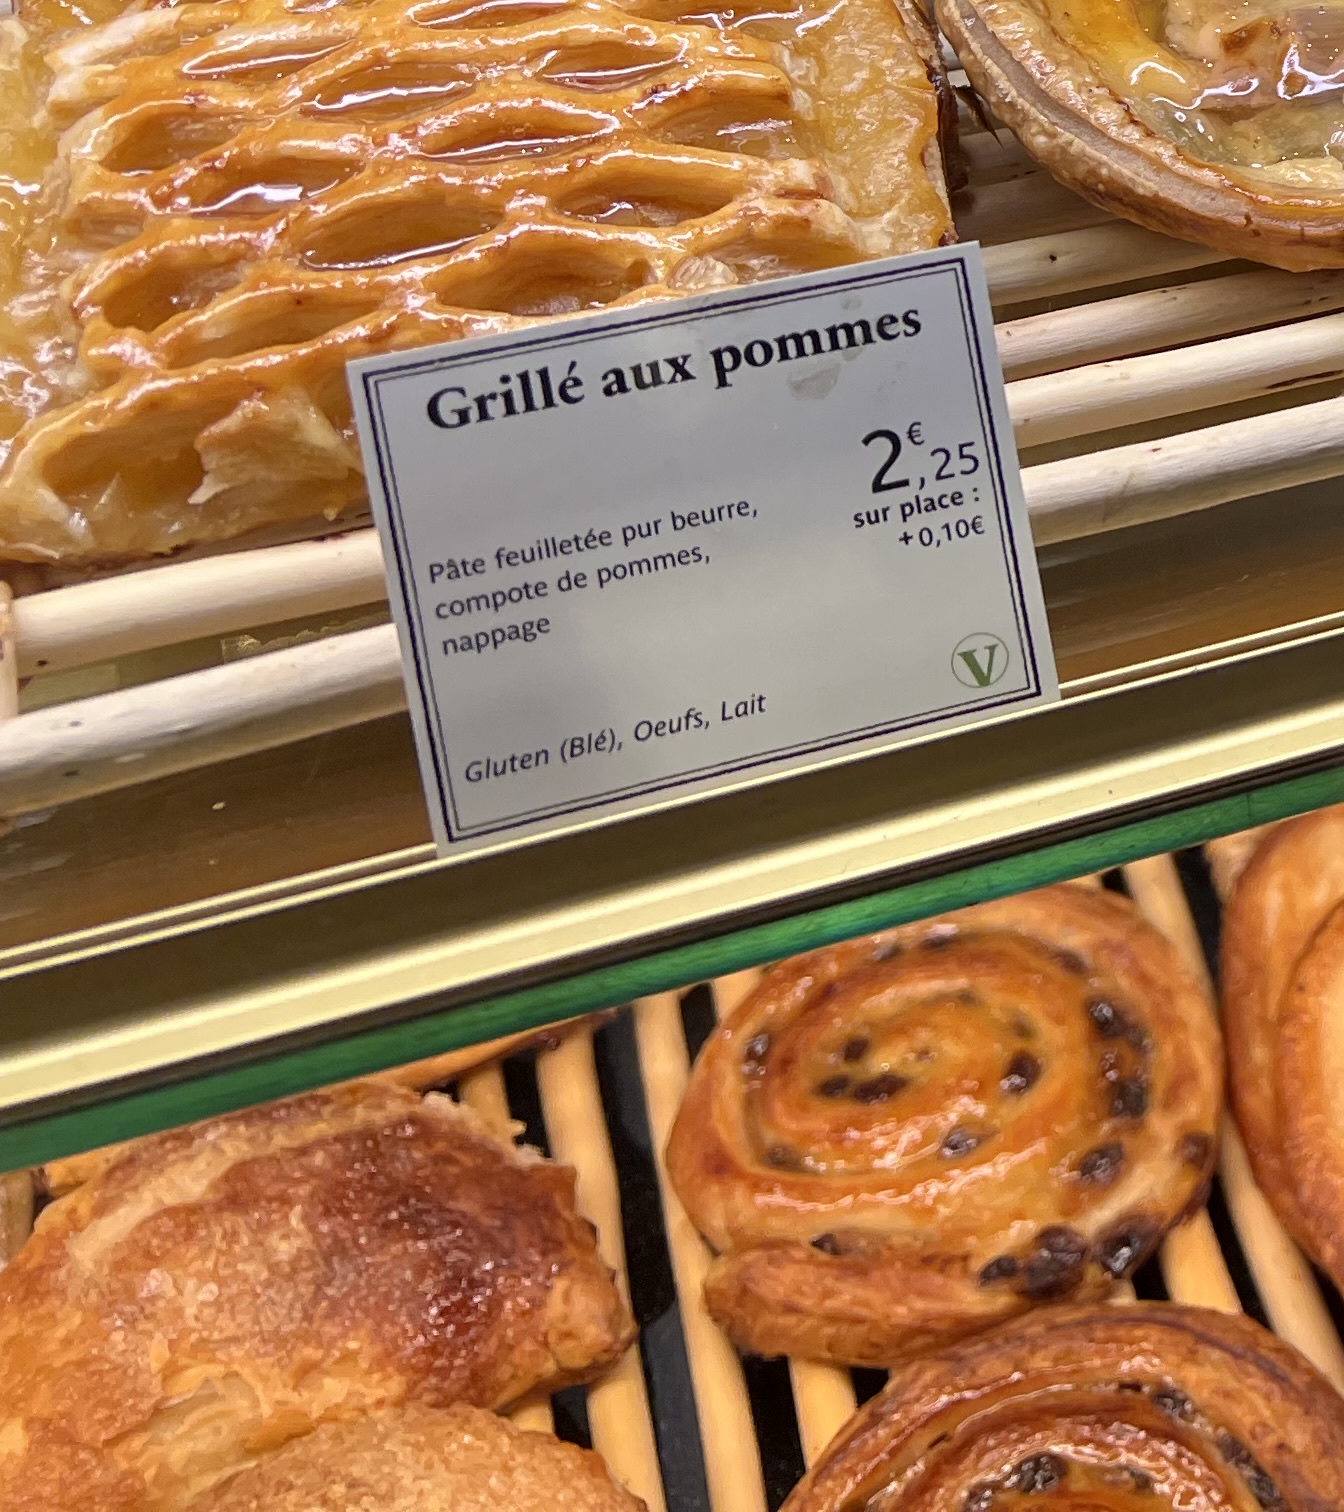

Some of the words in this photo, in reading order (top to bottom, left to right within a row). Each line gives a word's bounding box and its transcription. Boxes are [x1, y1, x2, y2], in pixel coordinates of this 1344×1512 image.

[426, 360, 585, 429] Grillé
[601, 353, 697, 398] aux
[709, 309, 922, 390] pommes
[429, 558, 486, 584] Pâte
[495, 528, 613, 569] feuilletée
[621, 518, 662, 548] pur
[670, 500, 757, 532] beurre,
[853, 506, 890, 529] sur
[899, 491, 964, 523] place
[435, 581, 549, 620] compote
[557, 570, 588, 593] de
[597, 546, 710, 589] pommes,
[442, 617, 550, 656] nappage
[957, 643, 1001, 689] V
[465, 748, 549, 783] Gluten
[560, 728, 623, 764] (Blé),
[633, 707, 710, 742] Oeufs,
[721, 693, 766, 722] Lait
